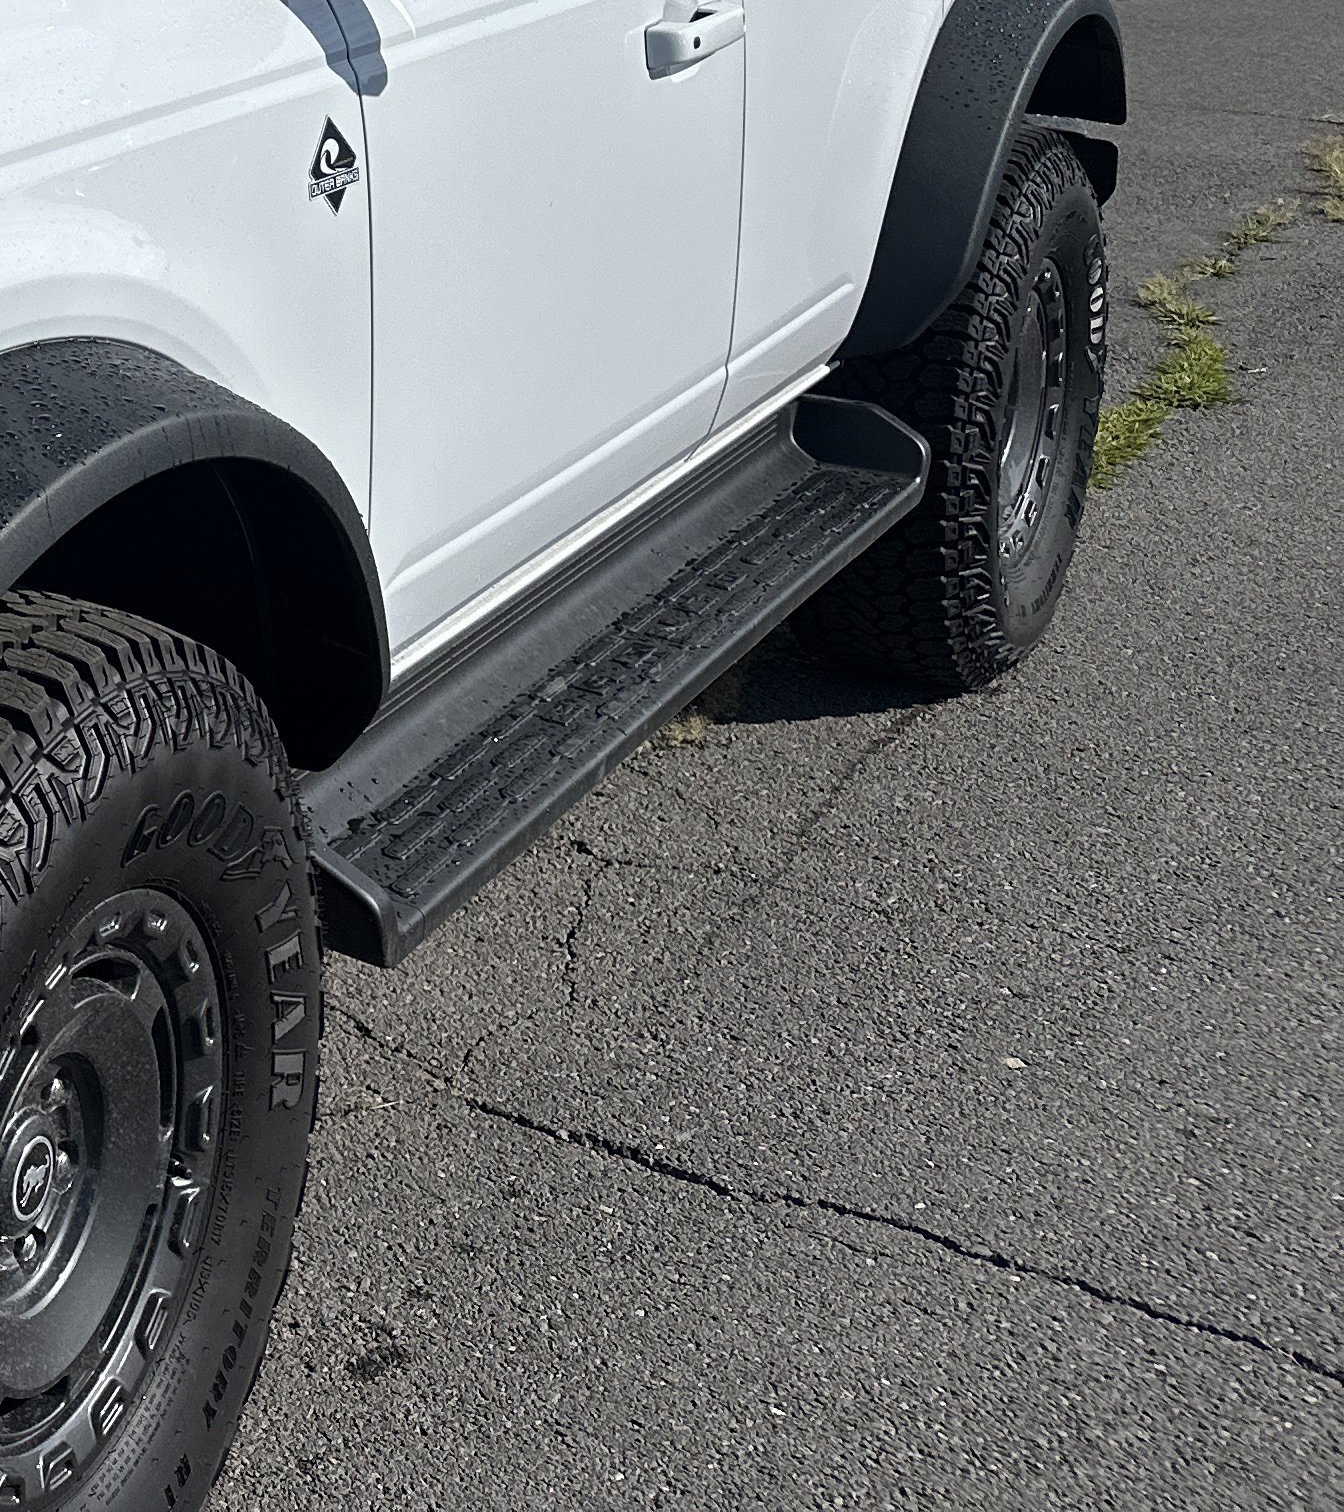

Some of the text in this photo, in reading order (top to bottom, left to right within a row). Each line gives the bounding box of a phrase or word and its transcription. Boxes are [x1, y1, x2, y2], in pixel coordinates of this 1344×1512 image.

[311, 179, 335, 196] OUTER
[122, 789, 306, 1113] GOODYEAR
[202, 1186, 282, 1432] TERRITORY
